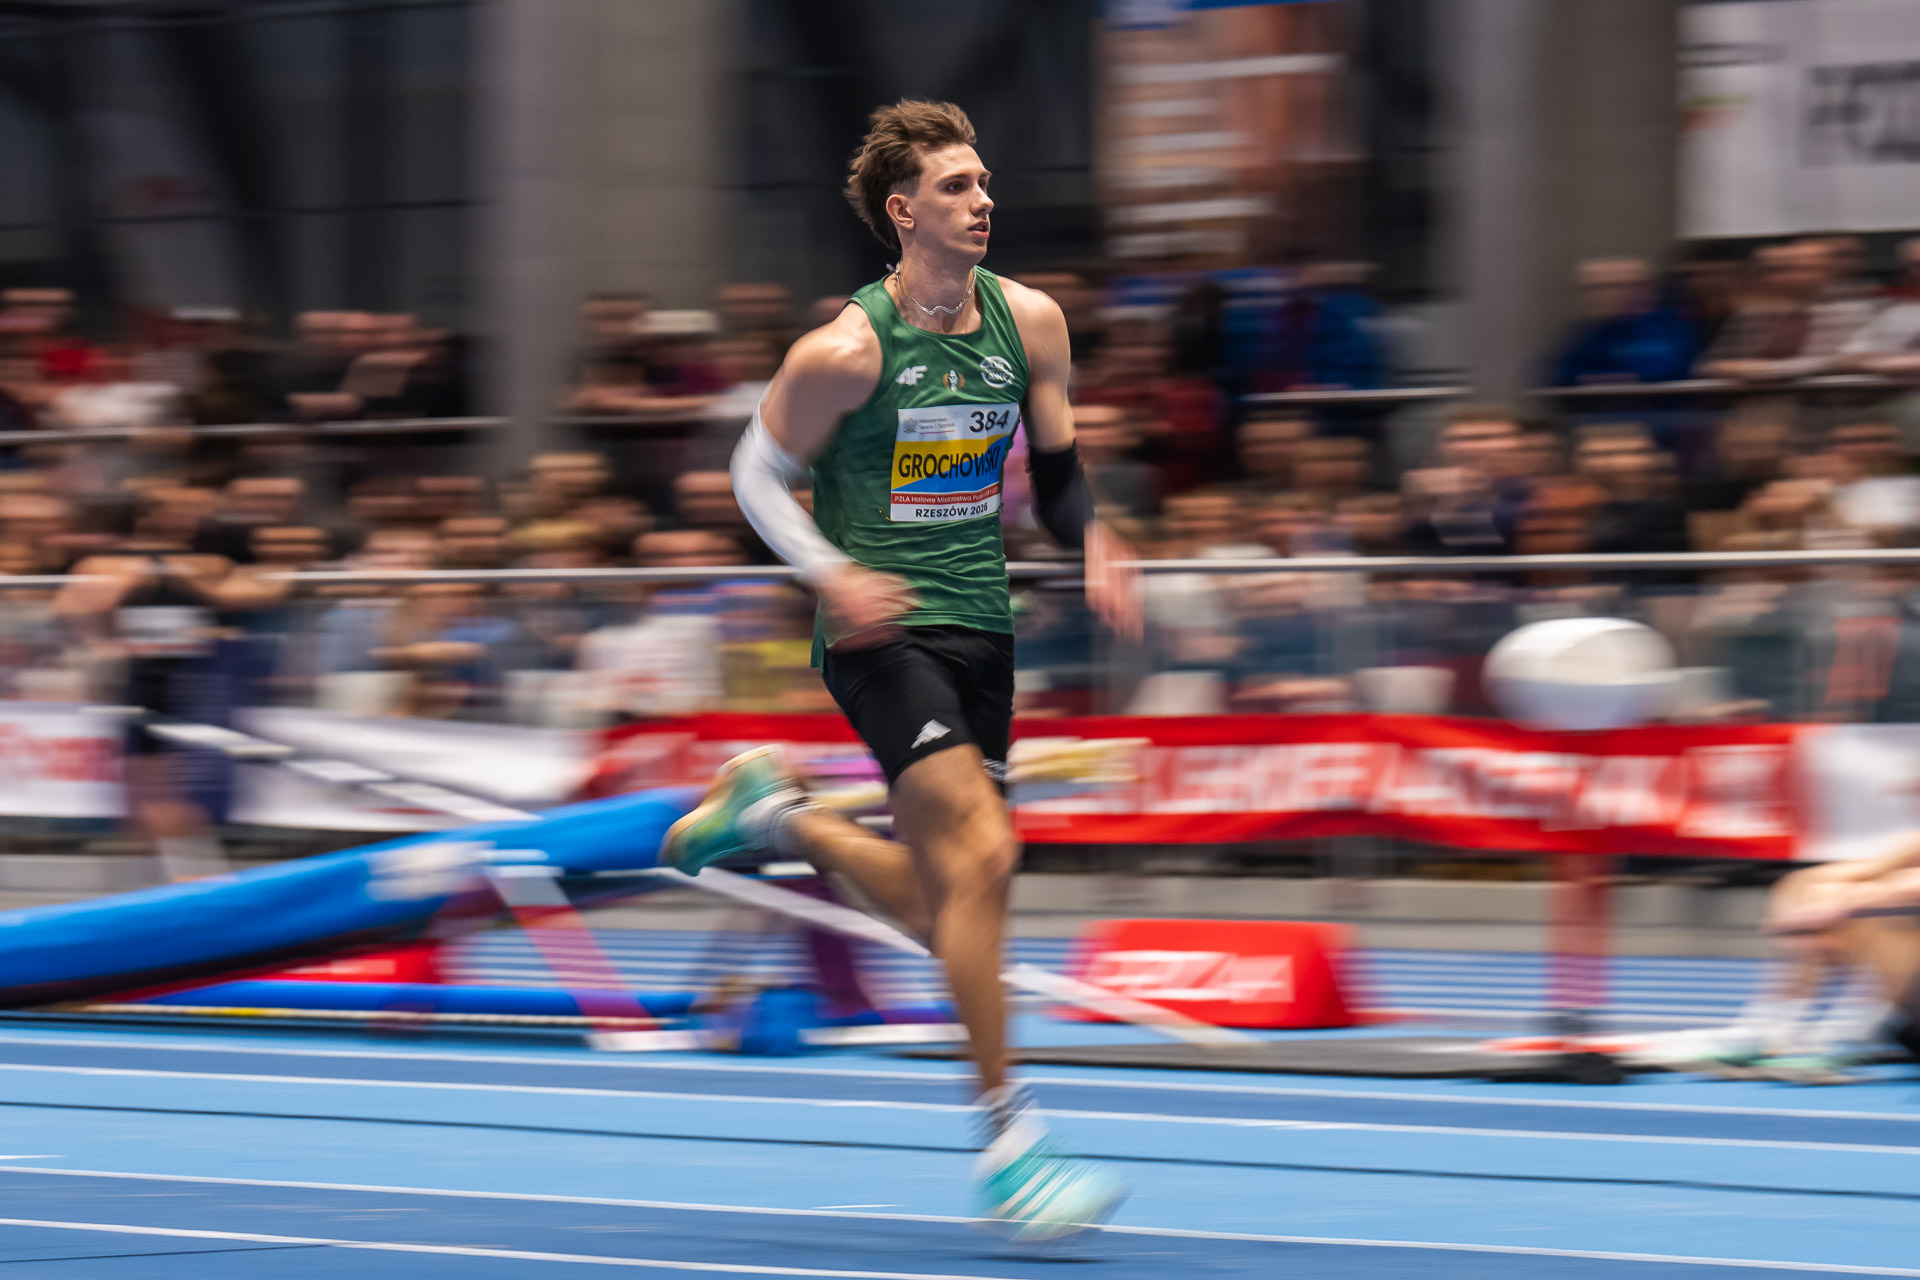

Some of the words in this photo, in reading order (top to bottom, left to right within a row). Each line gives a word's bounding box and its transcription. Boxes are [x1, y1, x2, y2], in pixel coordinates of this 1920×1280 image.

[969, 409, 1010, 433] 384
[898, 446, 1001, 478] GROCHOWSKI
[894, 495, 910, 503] PZLA
[915, 505, 968, 518] RZESZÓW
